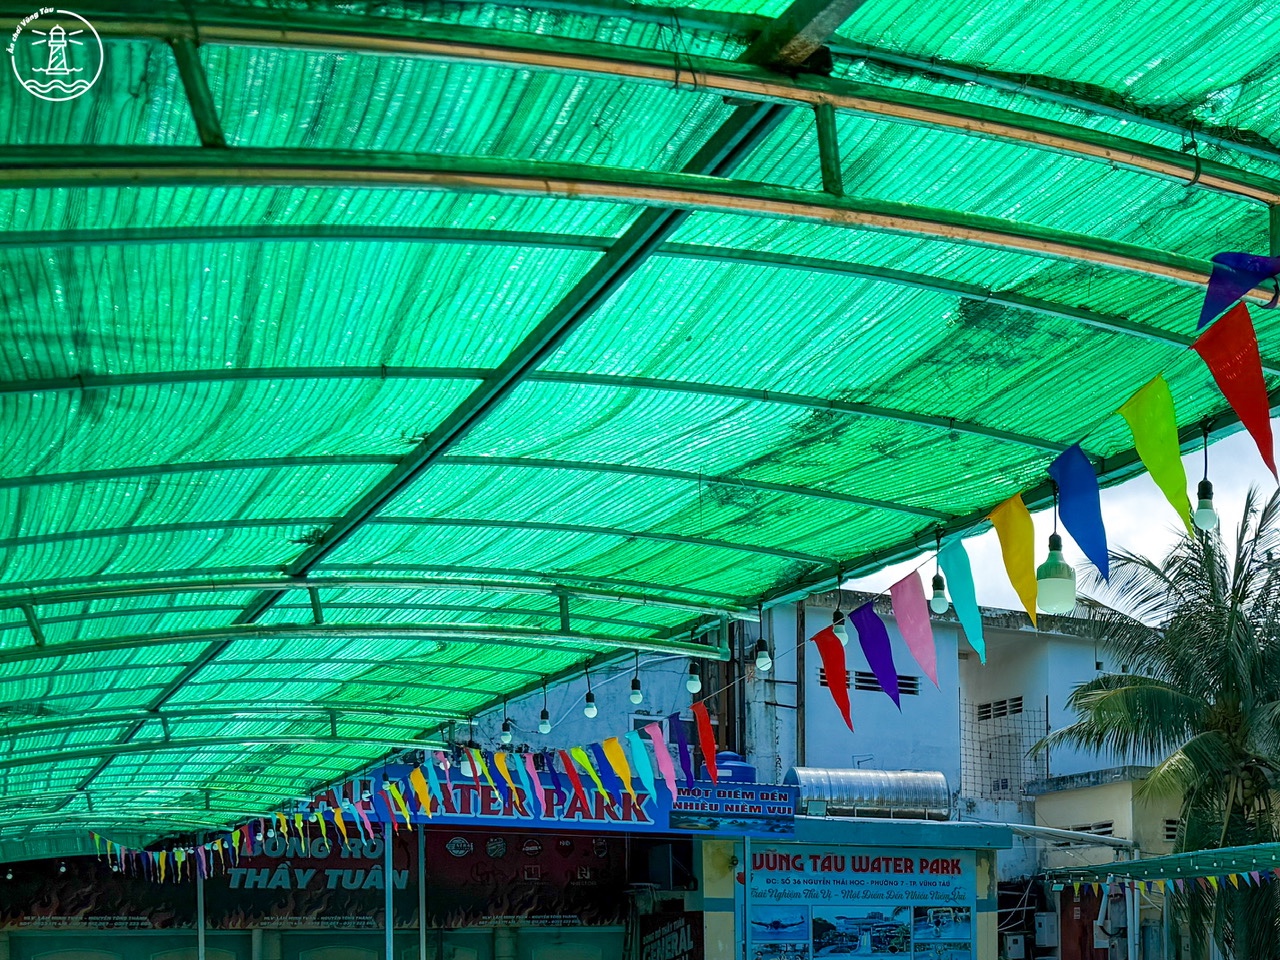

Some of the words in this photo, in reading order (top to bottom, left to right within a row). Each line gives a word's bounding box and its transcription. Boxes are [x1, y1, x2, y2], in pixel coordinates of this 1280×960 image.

[541, 786, 653, 824] PARK
[766, 806, 793, 814] VUI
[852, 855, 914, 873] WATER
[919, 858, 961, 875] PARK
